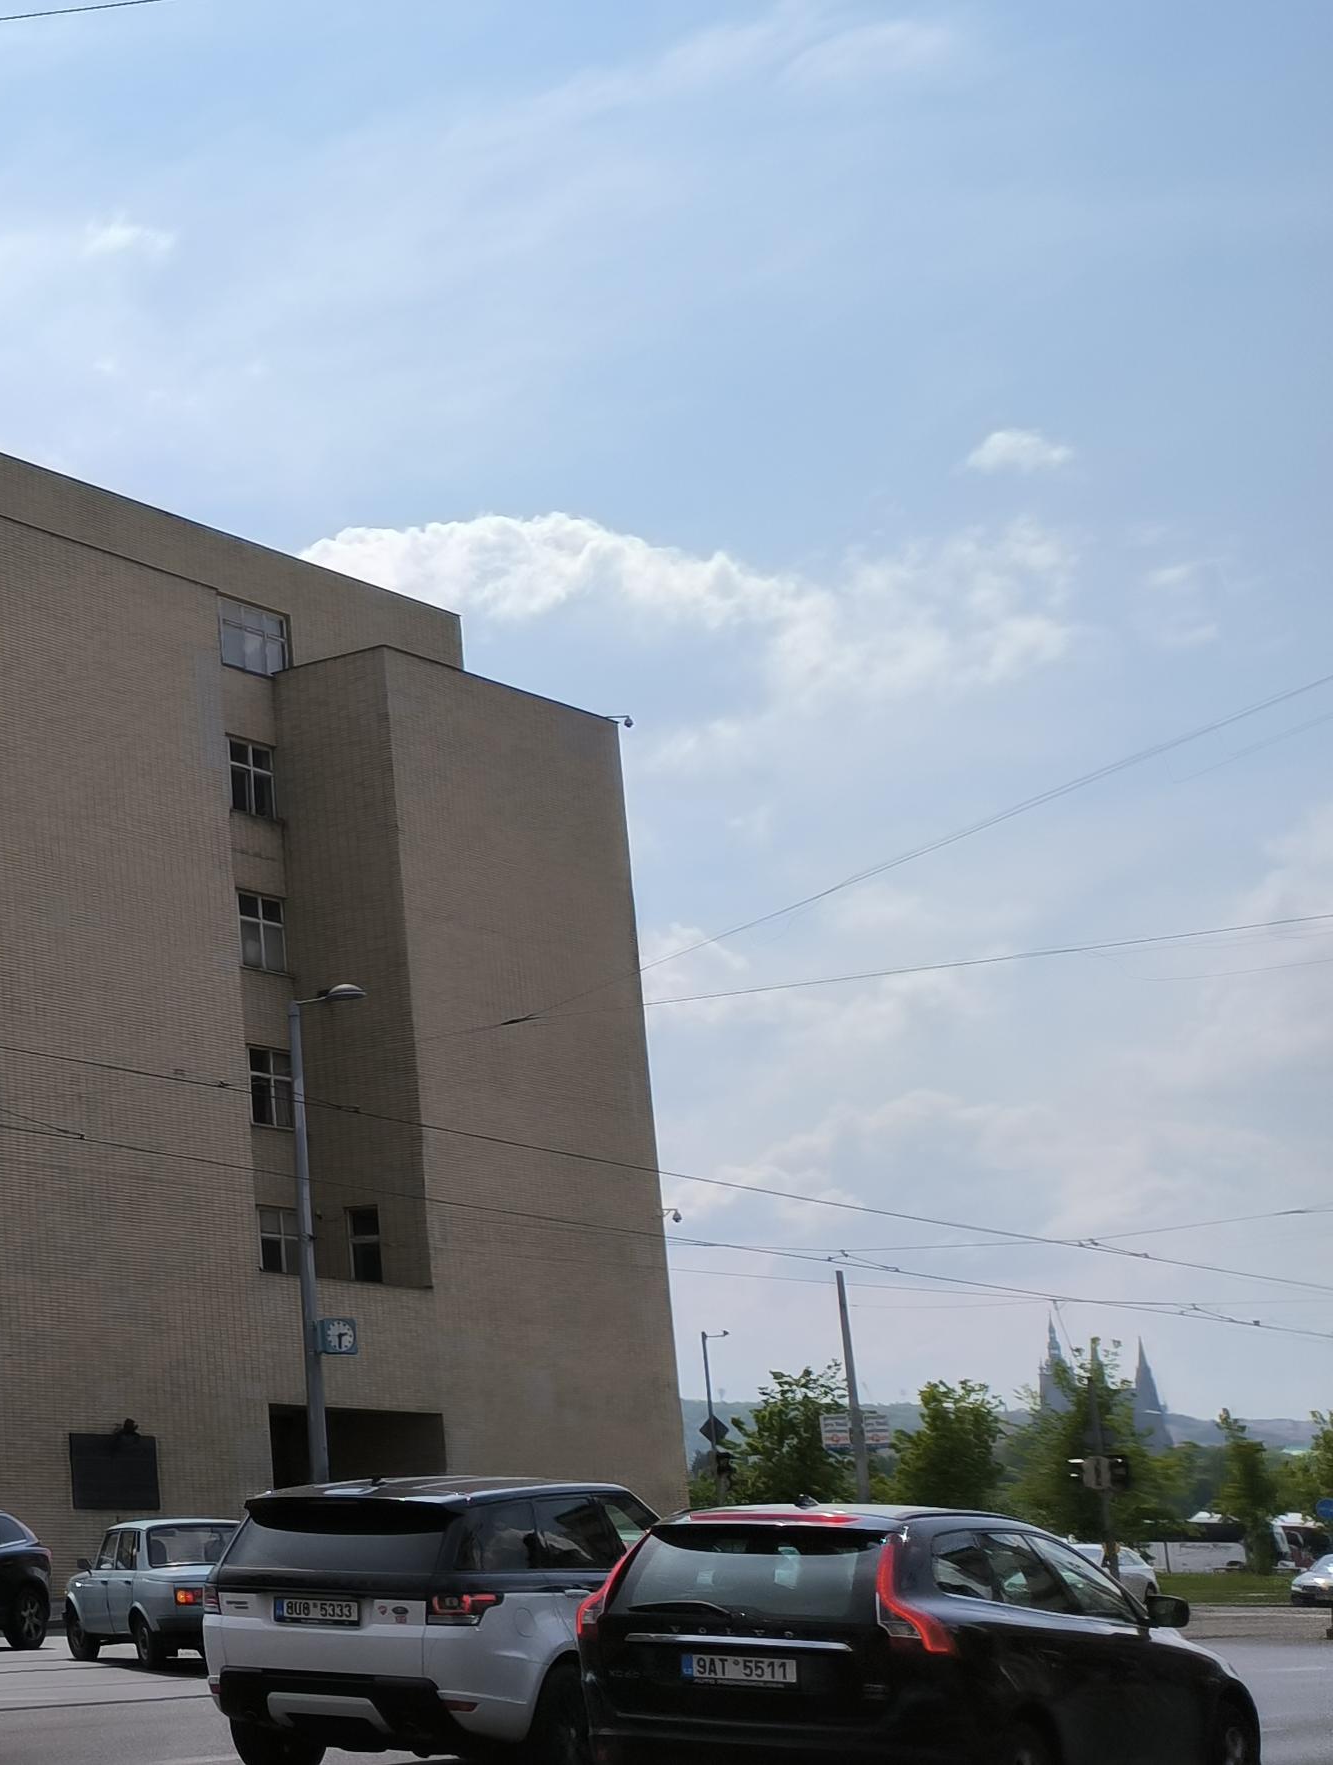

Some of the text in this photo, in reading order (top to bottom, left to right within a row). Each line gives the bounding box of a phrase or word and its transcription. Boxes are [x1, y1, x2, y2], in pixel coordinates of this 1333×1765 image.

[320, 1602, 352, 1618] 5333
[670, 1626, 794, 1639] VOLVO
[697, 1658, 788, 1681] 9AT 5511
